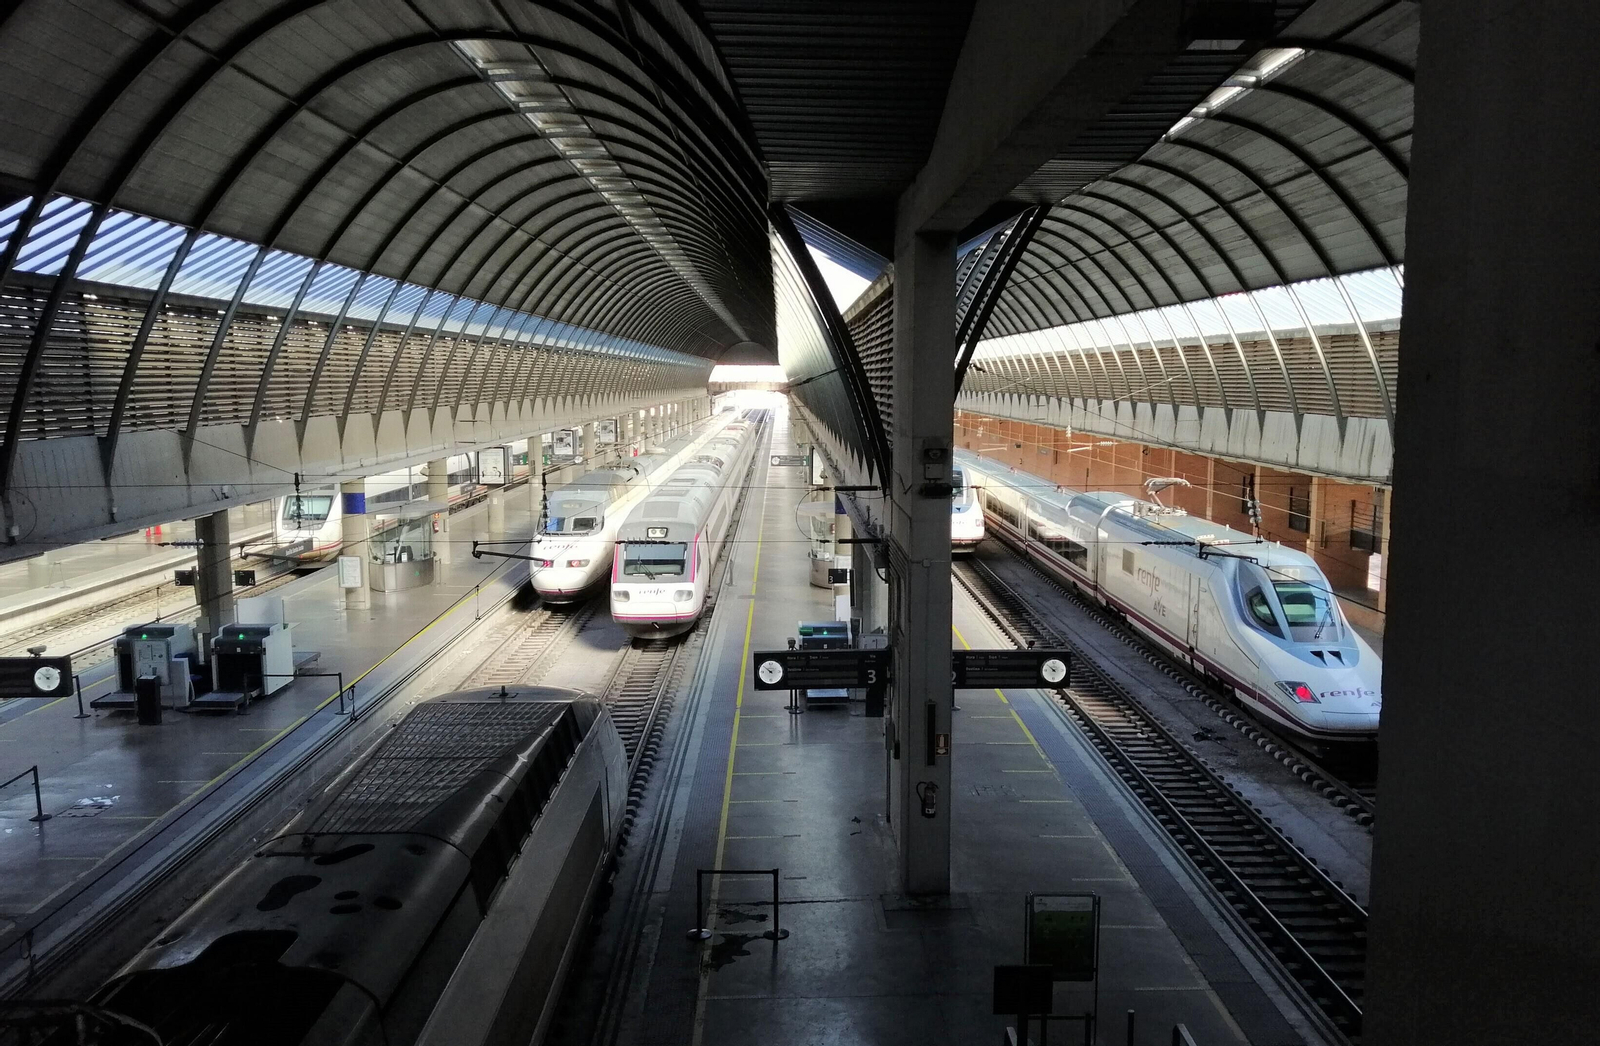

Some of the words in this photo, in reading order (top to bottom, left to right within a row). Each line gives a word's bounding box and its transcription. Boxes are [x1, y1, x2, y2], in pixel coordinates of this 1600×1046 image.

[828, 575, 834, 584] 3
[1137, 565, 1161, 598] renfe
[1152, 596, 1166, 618] AVE
[867, 669, 877, 684] 3
[1320, 686, 1375, 699] renfe
